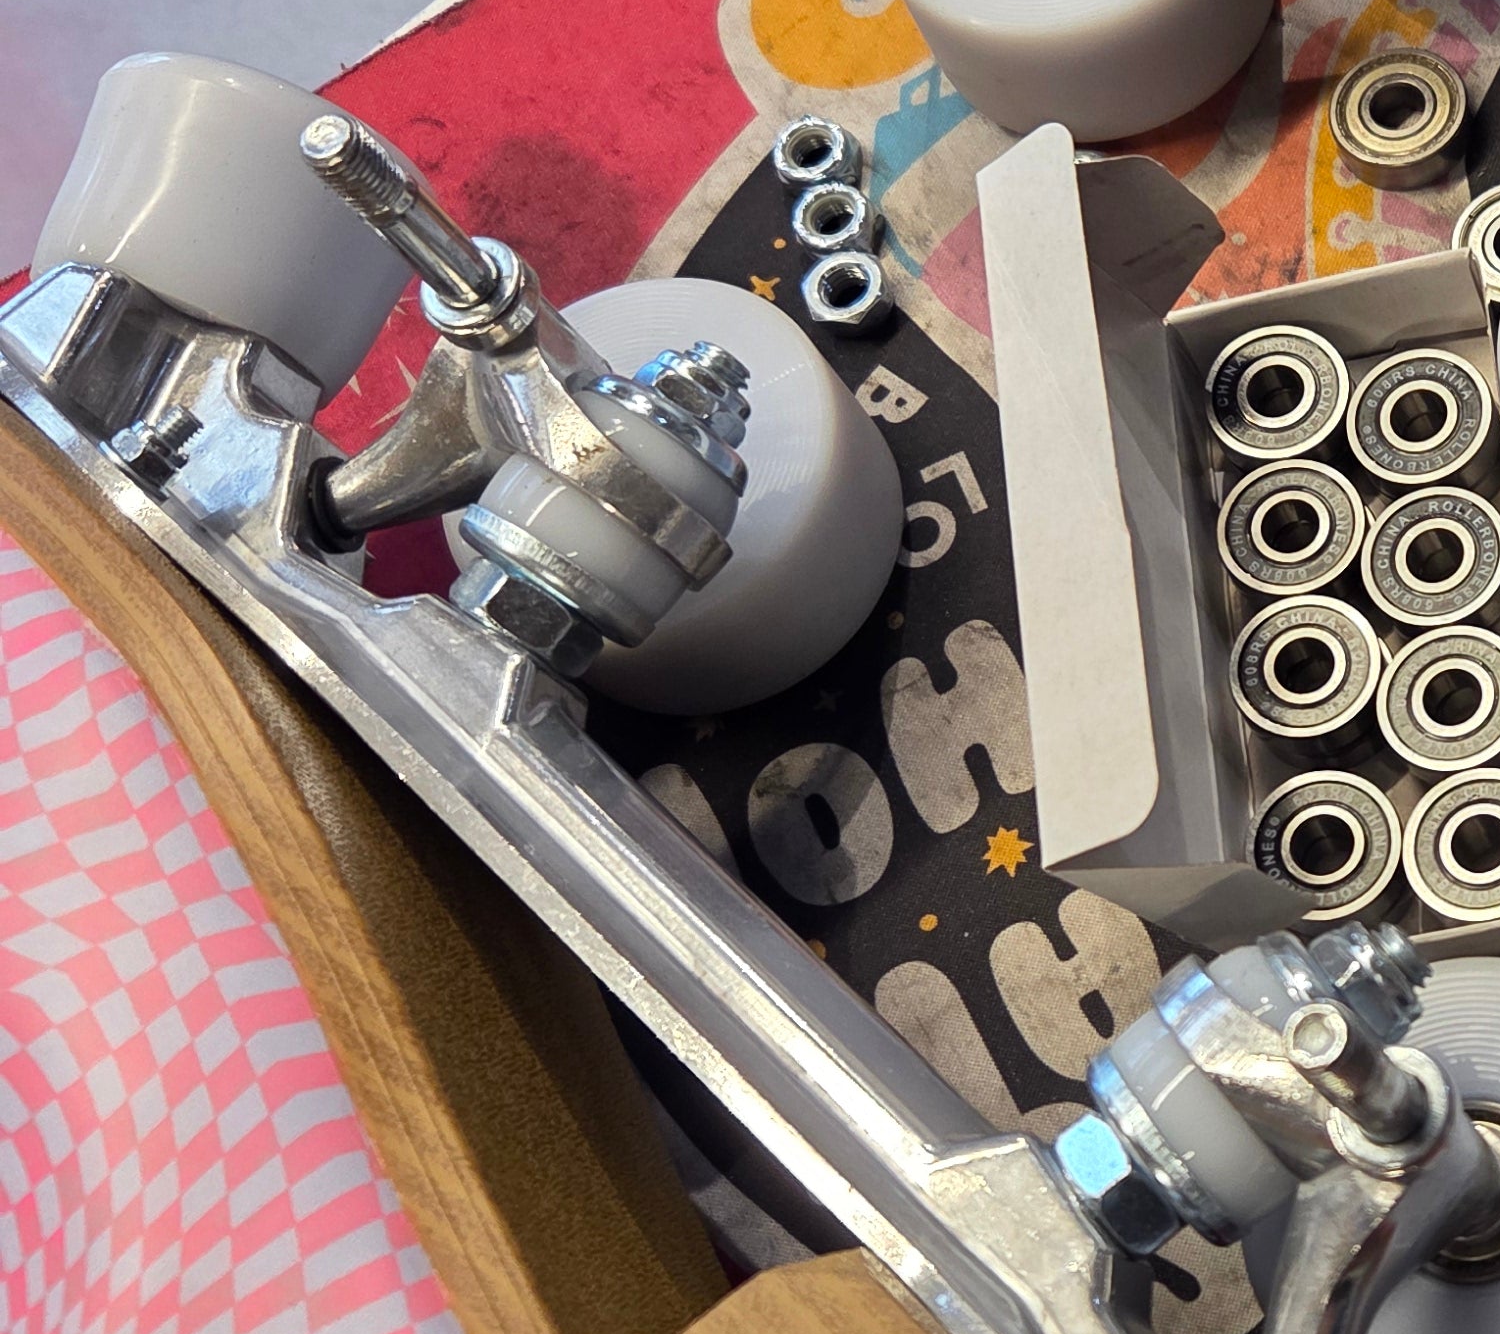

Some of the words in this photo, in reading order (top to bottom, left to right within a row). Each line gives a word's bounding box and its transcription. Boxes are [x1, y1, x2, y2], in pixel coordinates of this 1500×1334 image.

[1425, 364, 1475, 401] CHINA
[1230, 502, 1252, 558] CHINA
[1377, 515, 1412, 570] CHINA
[1275, 611, 1339, 631] CHINA
